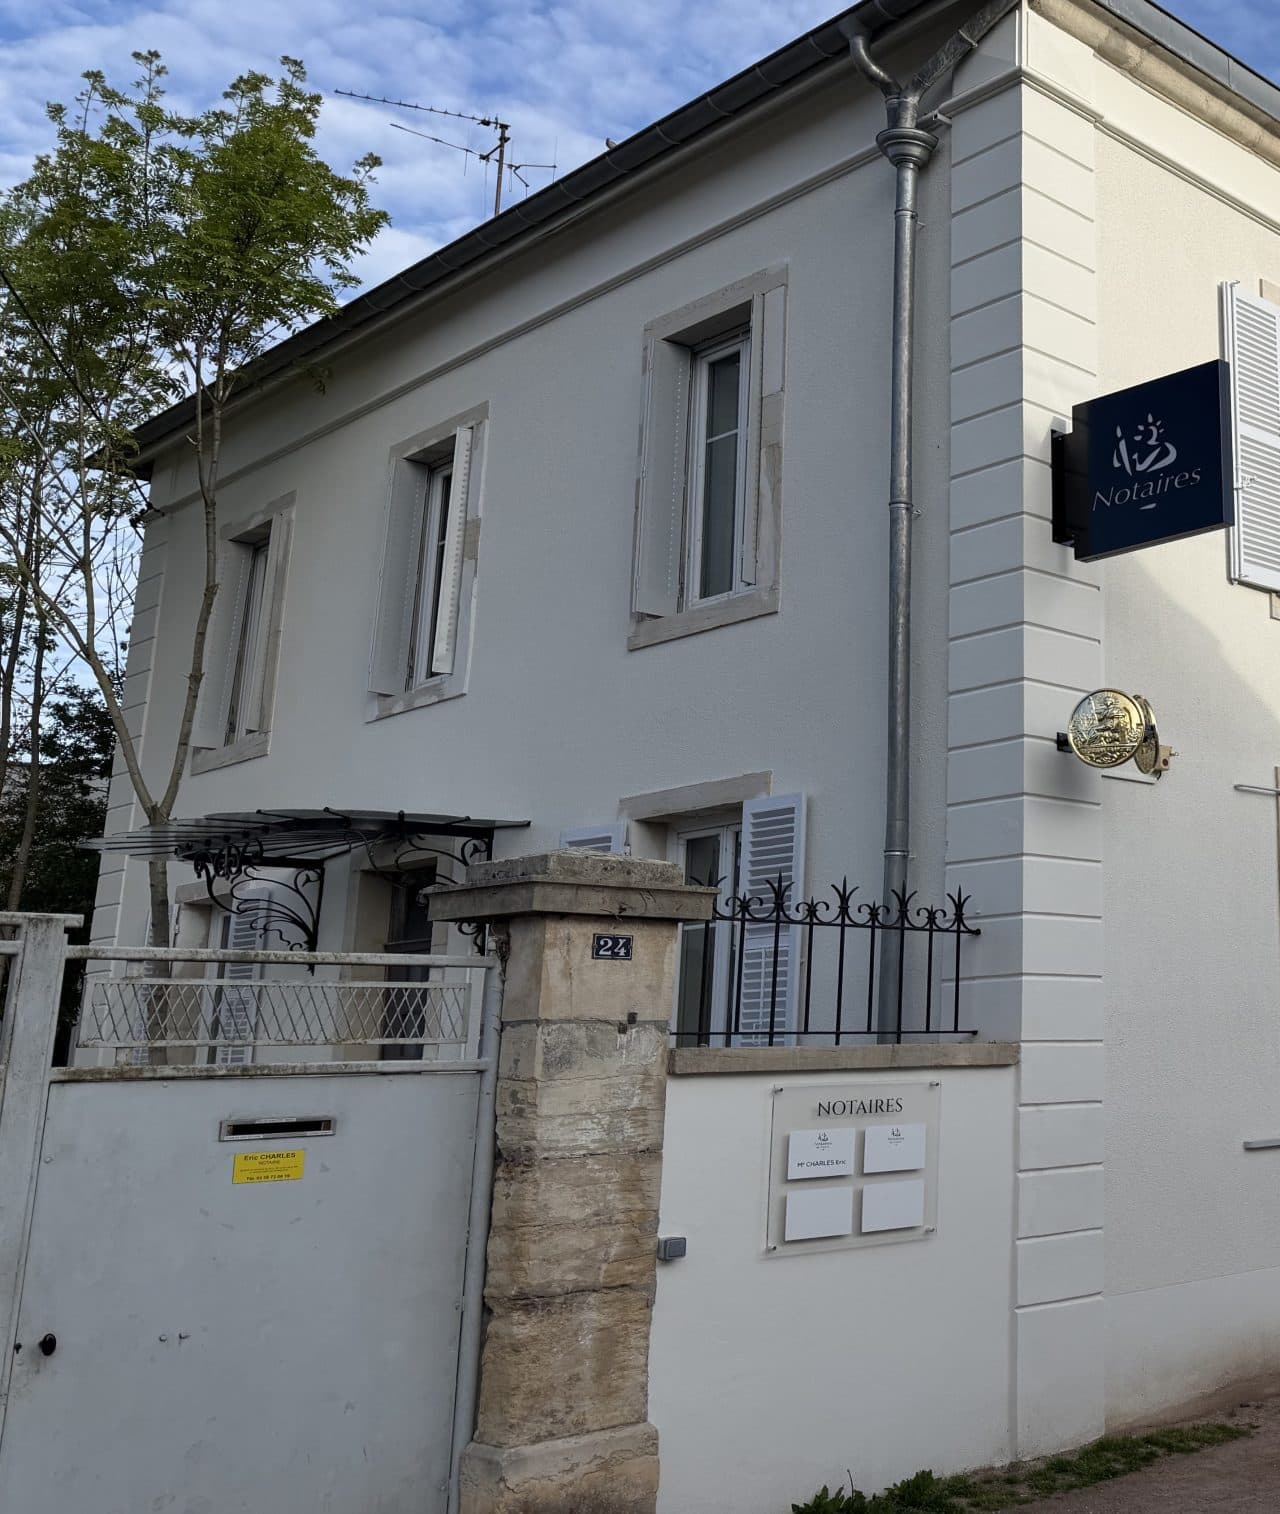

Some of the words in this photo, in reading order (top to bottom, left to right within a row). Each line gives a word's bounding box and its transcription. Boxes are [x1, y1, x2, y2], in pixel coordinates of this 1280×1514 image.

[1092, 468, 1201, 511] Notaires
[598, 938, 627, 956] 24
[817, 1097, 904, 1117] NOTAIRES
[260, 1152, 296, 1160] CHARLES
[805, 1160, 834, 1168] CHARLES
